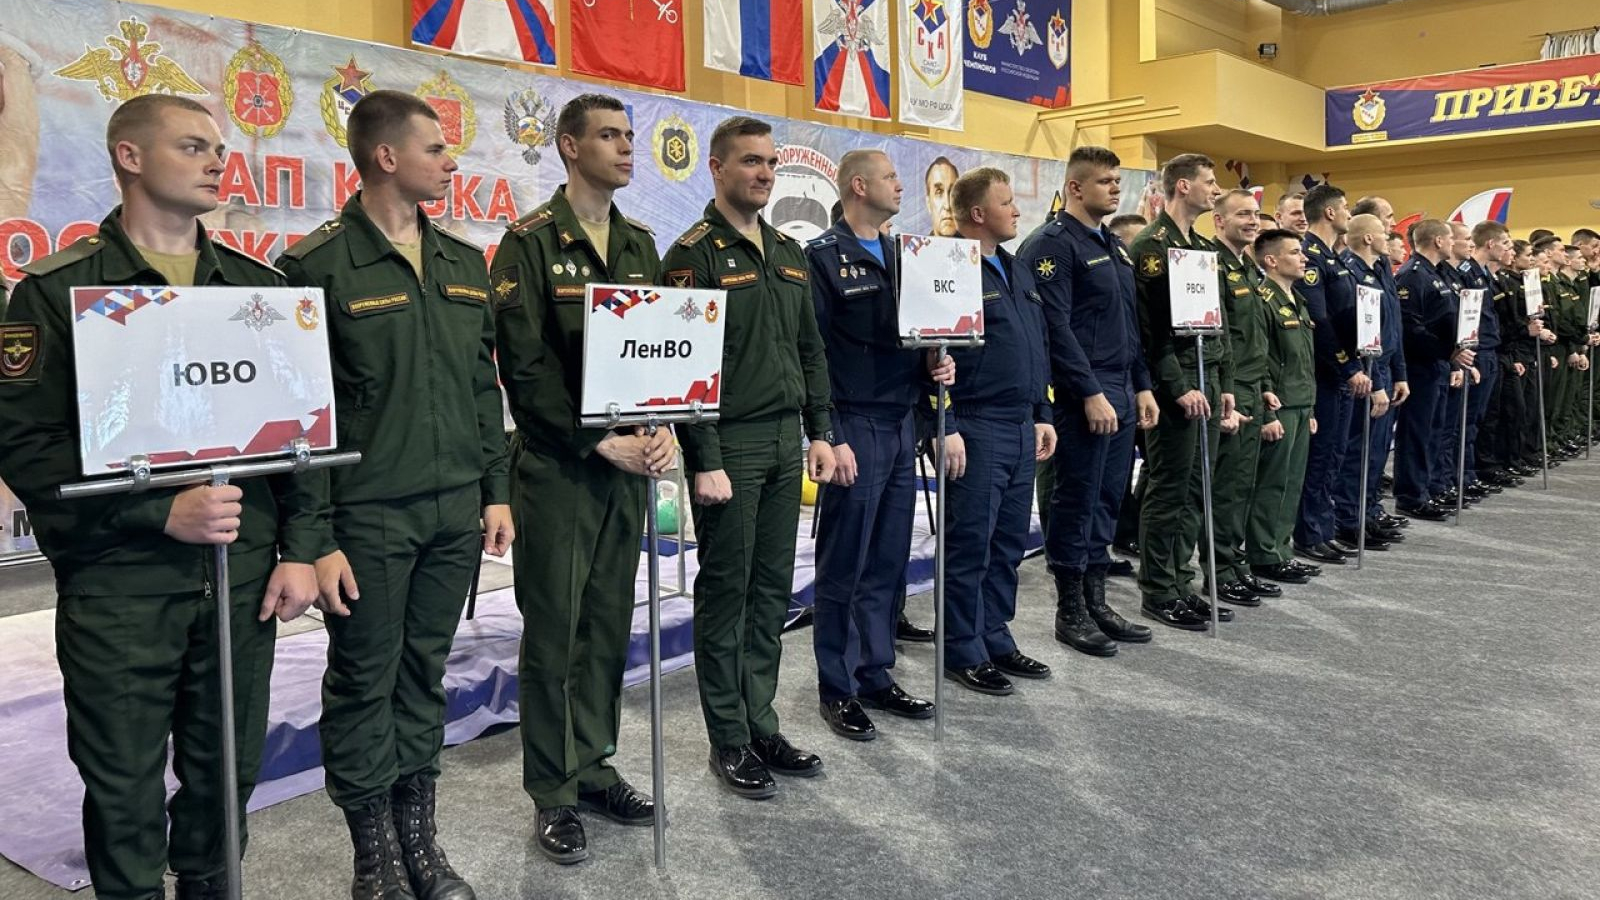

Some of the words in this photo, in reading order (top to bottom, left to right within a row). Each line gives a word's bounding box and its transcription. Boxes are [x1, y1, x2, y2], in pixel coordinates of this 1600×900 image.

[929, 102, 937, 110] РФ
[775, 147, 838, 182] ООРУЖЕННЫ
[333, 161, 519, 223] ККА
[934, 279, 955, 294] ВКС
[1186, 282, 1206, 295] РВСН
[620, 339, 692, 359] ЛенВО
[173, 360, 257, 387] ЮВО
